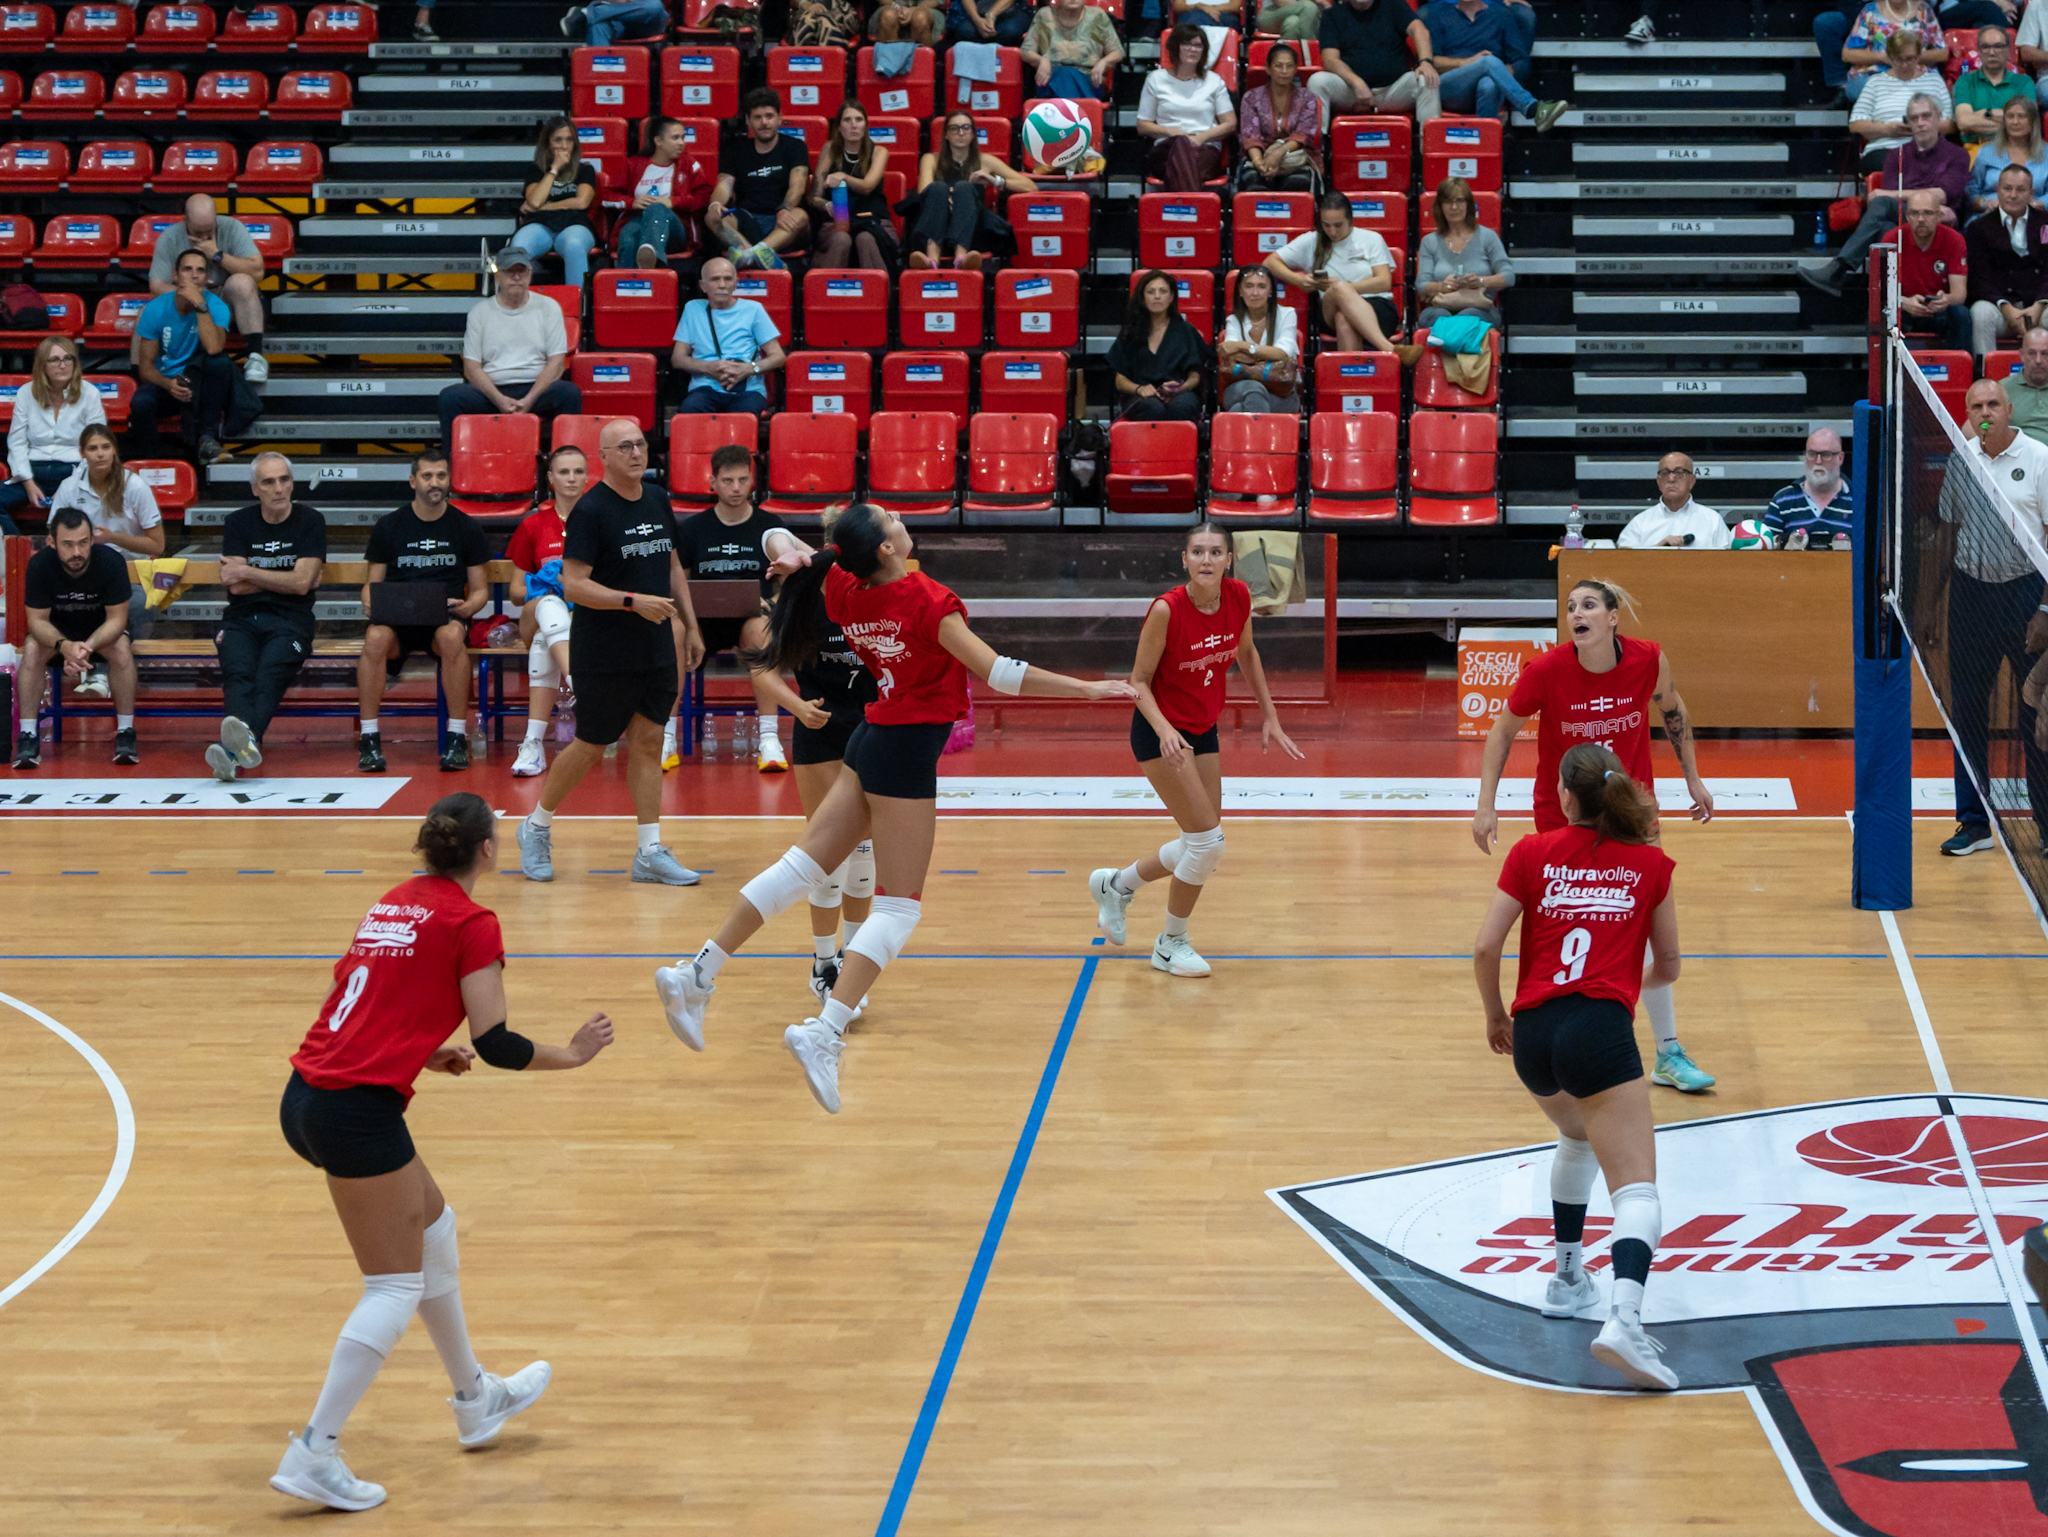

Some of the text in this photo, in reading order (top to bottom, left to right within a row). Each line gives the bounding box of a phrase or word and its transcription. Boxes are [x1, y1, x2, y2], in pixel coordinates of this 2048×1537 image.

[450, 80, 471, 88] FILA
[1670, 79, 1692, 87] FILA
[421, 150, 443, 158] FILA
[1058, 145, 1084, 162] molten
[1668, 150, 1690, 158] FILA
[395, 223, 417, 232] FILA
[1671, 223, 1693, 231] FILA
[1674, 302, 1695, 310] FILA
[340, 383, 363, 392] FILA
[1676, 382, 1698, 391] FILA
[1464, 651, 1522, 665] SCEGLI
[1466, 664, 1519, 673] LA PERSONA
[848, 670, 860, 689] 7
[1204, 669, 1214, 686] 2
[1462, 672, 1520, 686] GIUSTA
[1468, 699, 1481, 712] D
[1561, 711, 1642, 740] PRIMATO
[1543, 864, 1642, 887] futuravolley
[1544, 880, 1632, 903] Giovani
[1537, 905, 1634, 922] BUSTO ARSIZIO
[350, 946, 366, 956] STO
[1553, 928, 1592, 985] 9
[328, 965, 369, 1032] 8
